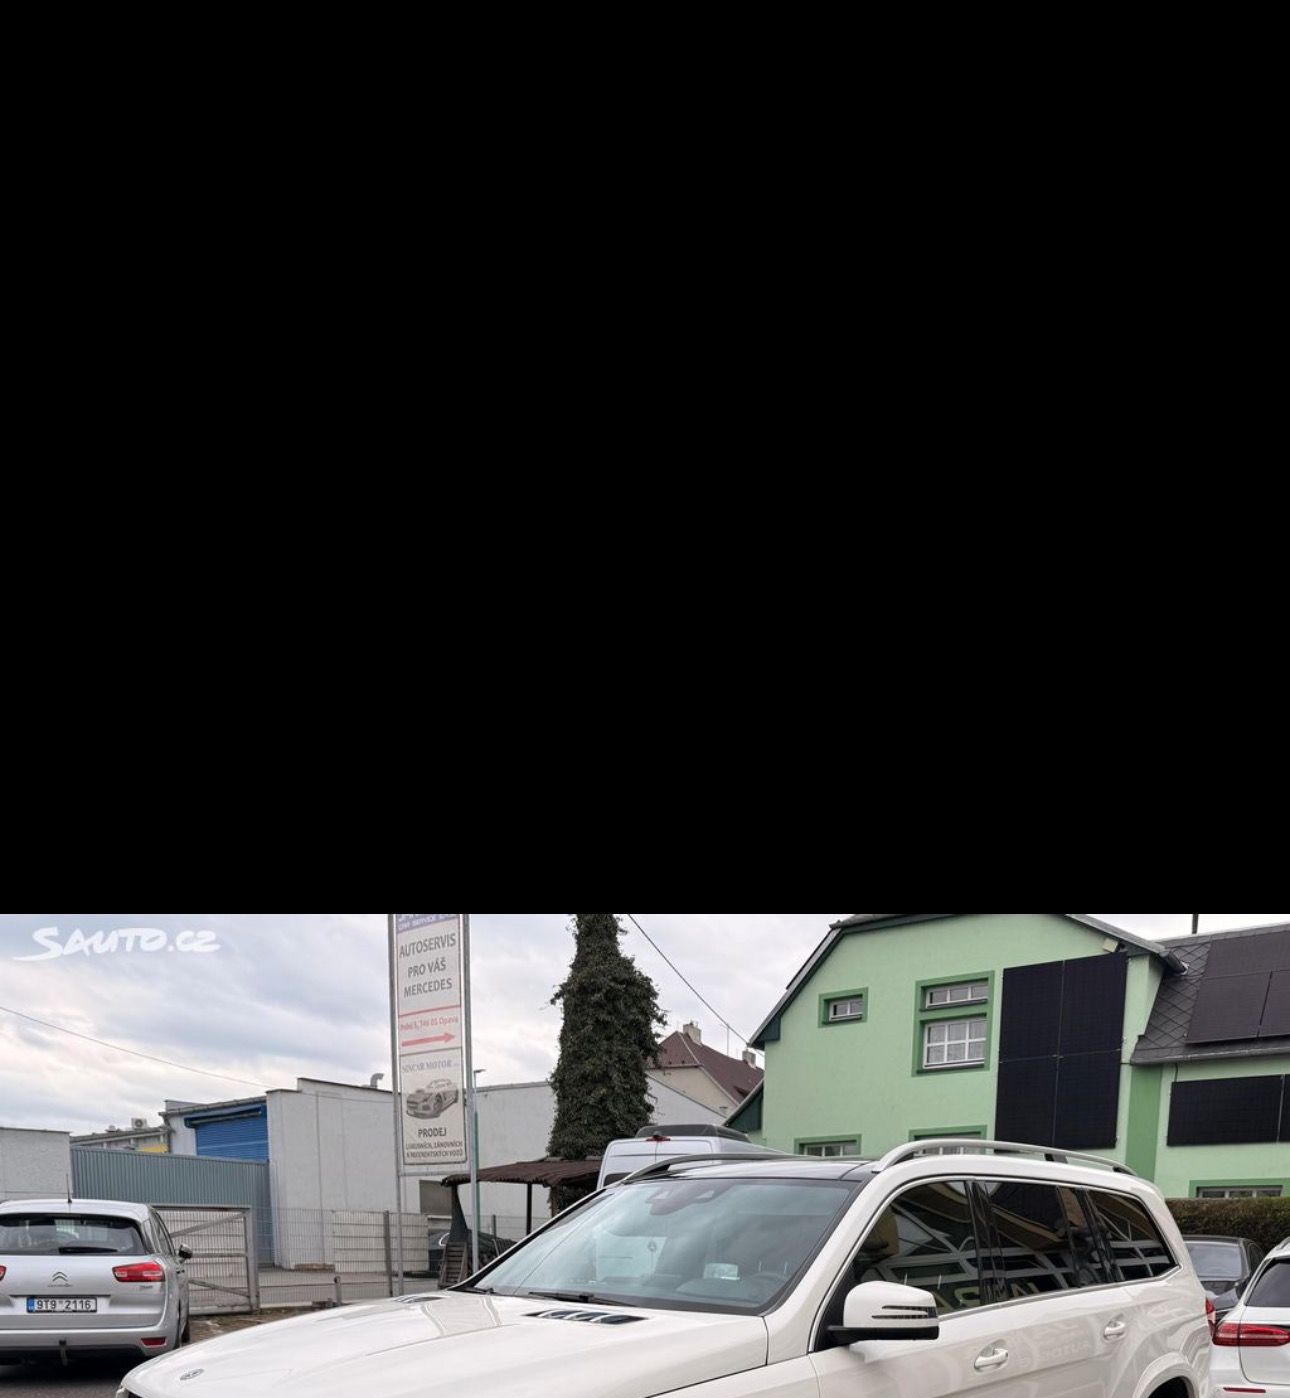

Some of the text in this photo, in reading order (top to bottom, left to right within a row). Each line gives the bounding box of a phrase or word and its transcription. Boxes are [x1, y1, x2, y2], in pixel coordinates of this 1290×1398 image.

[399, 933, 456, 958] AUTOSERVIS
[408, 957, 447, 978] PRO VÁŠ
[403, 978, 453, 998] MERCEDES
[426, 1059, 452, 1070] MOTOR
[418, 1127, 447, 1138] PRODEJ
[37, 1300, 56, 1309] 9T9
[65, 1300, 91, 1309] 2116
